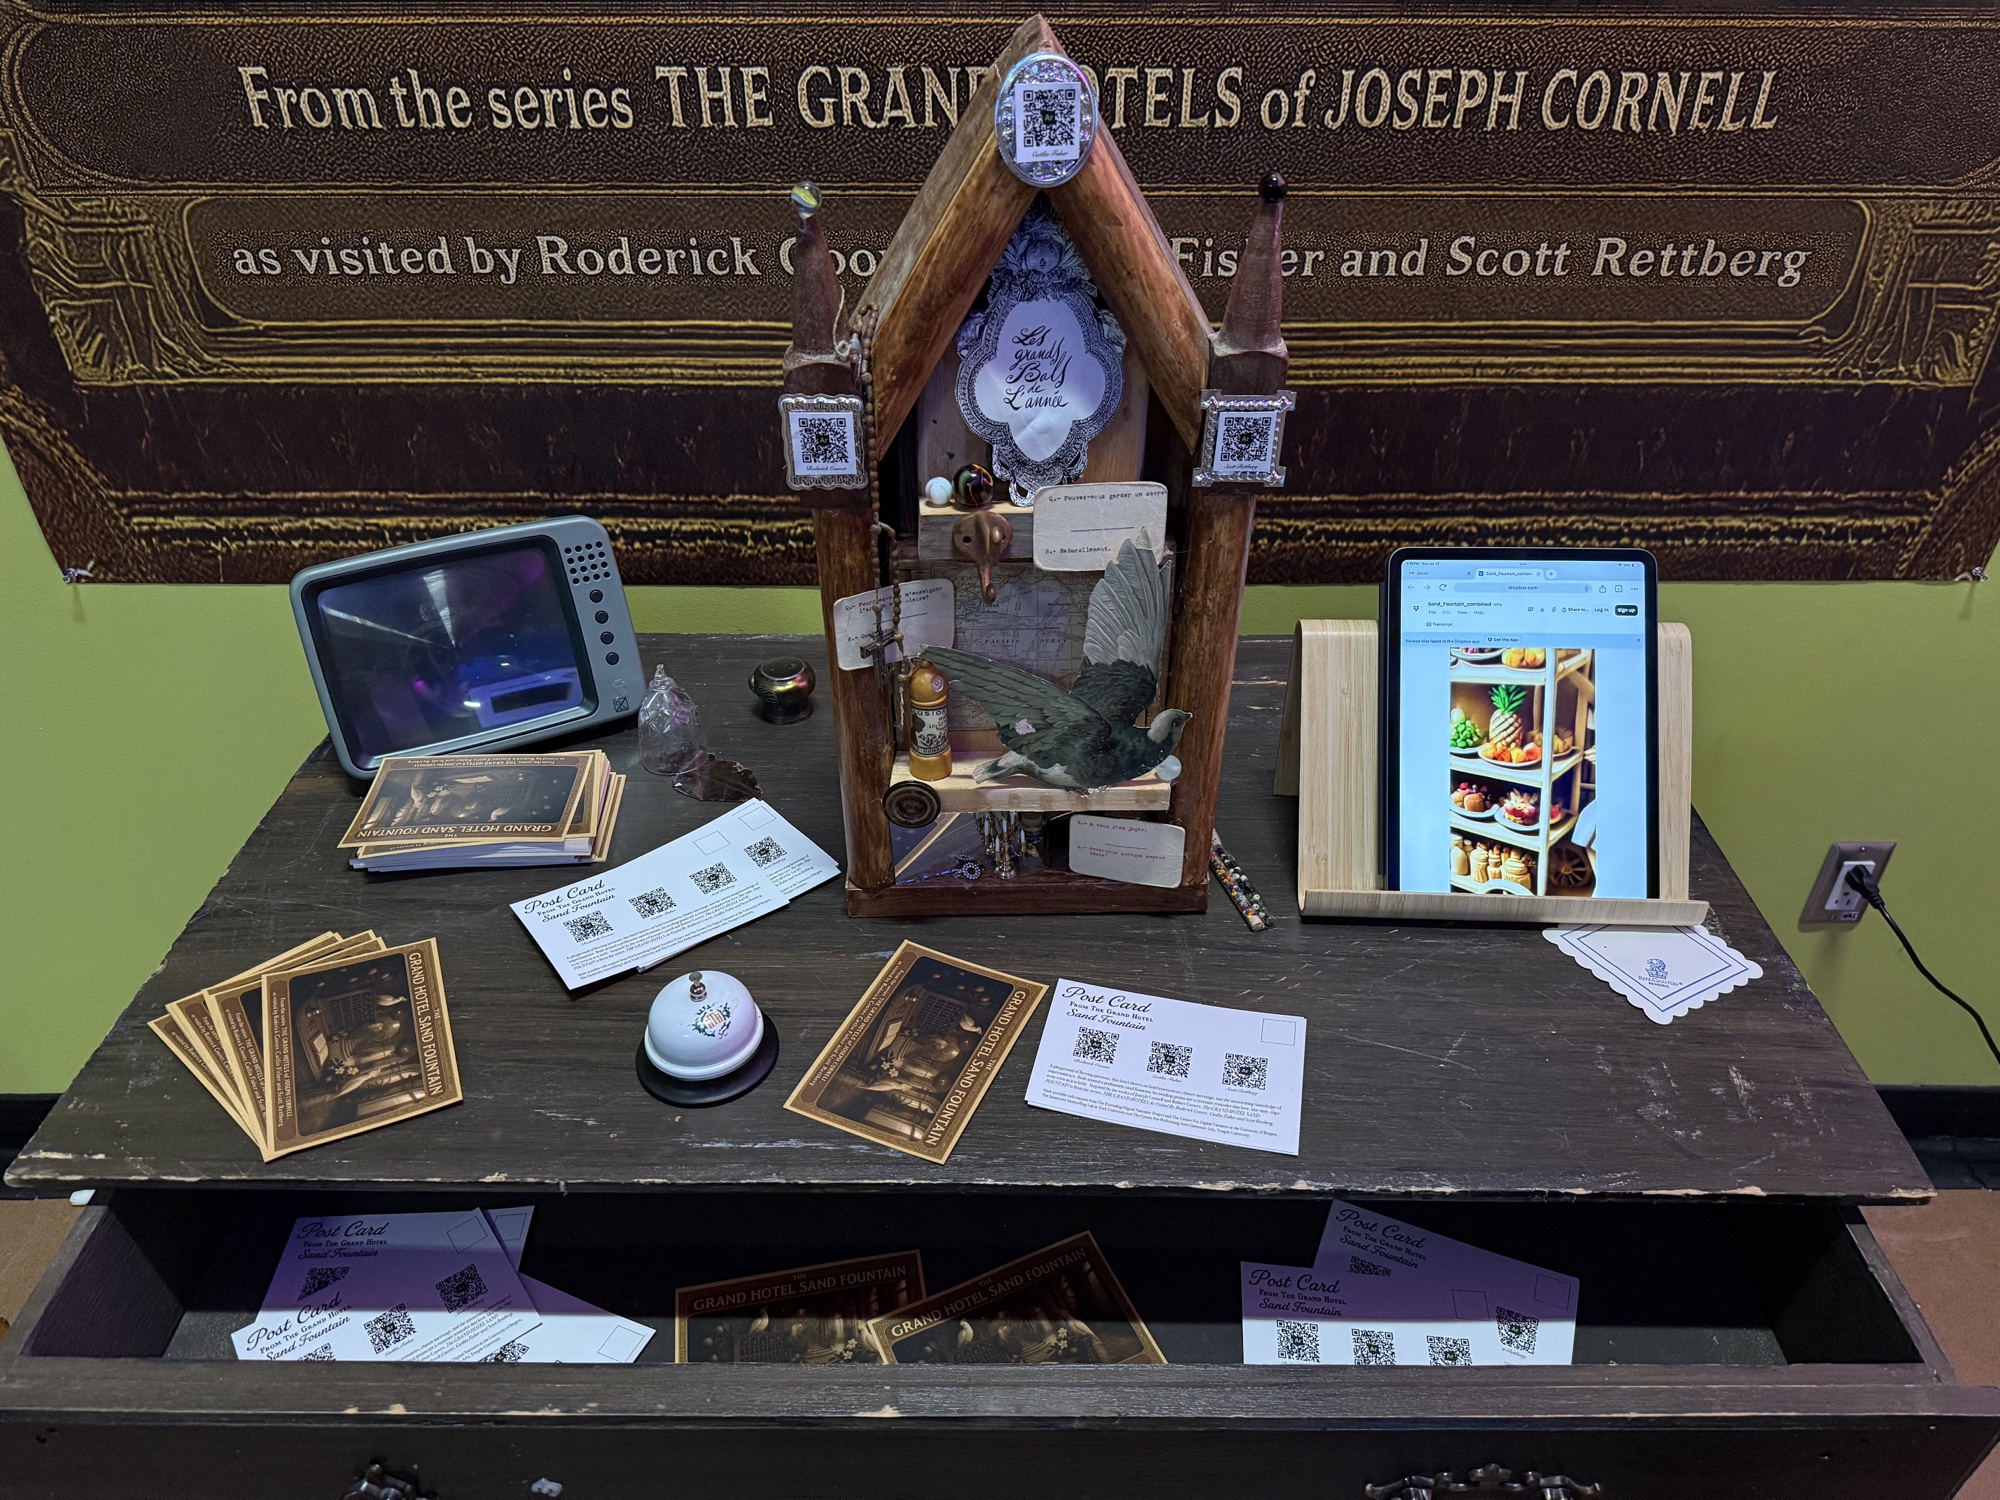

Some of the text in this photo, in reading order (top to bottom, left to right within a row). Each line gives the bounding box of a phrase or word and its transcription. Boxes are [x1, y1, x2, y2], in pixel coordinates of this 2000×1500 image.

[237, 66, 383, 130] From
[389, 69, 472, 129] the
[487, 69, 633, 130] series
[655, 64, 774, 129] THE
[1259, 64, 1314, 131] of
[1323, 64, 1523, 133] JOSEPH
[1541, 64, 1779, 136] CORNELL
[234, 243, 282, 276] as
[292, 238, 457, 276] visited
[469, 236, 523, 285] by
[538, 235, 761, 276] Roderick
[1171, 237, 1812, 288] Fiser and Scott Rettberg
[1012, 326, 1052, 346] Les
[1006, 351, 1073, 388] Bals
[1027, 381, 1046, 393] de
[358, 827, 418, 836] FOUNTAIN
[525, 880, 605, 914] Post Card
[543, 895, 615, 922] Sand Fountain
[1062, 986, 1151, 1012] Post Card
[409, 952, 441, 1094] GRAND HOTEL SAND FOUNTAIN
[1066, 1008, 1145, 1030] Sand Fountain
[926, 991, 1025, 1144] GRAND HOTEL SAND FOUNTAIN
[298, 1220, 389, 1238] Post Card
[1335, 1209, 1425, 1248] Post Card
[298, 1247, 377, 1259] Sand Fountain
[1339, 1234, 1417, 1268] Sand Fountain
[693, 1264, 907, 1310] GRAND HOTEL SAND FOUNTAIN
[889, 1247, 1088, 1337] GRAND HOTEL SAND FOUNTAIN
[1248, 1269, 1339, 1293] Post Card
[246, 1292, 341, 1350] Post Card
[1259, 1297, 1341, 1316] Sand Fountain
[266, 1317, 350, 1363] Sand Fountain
